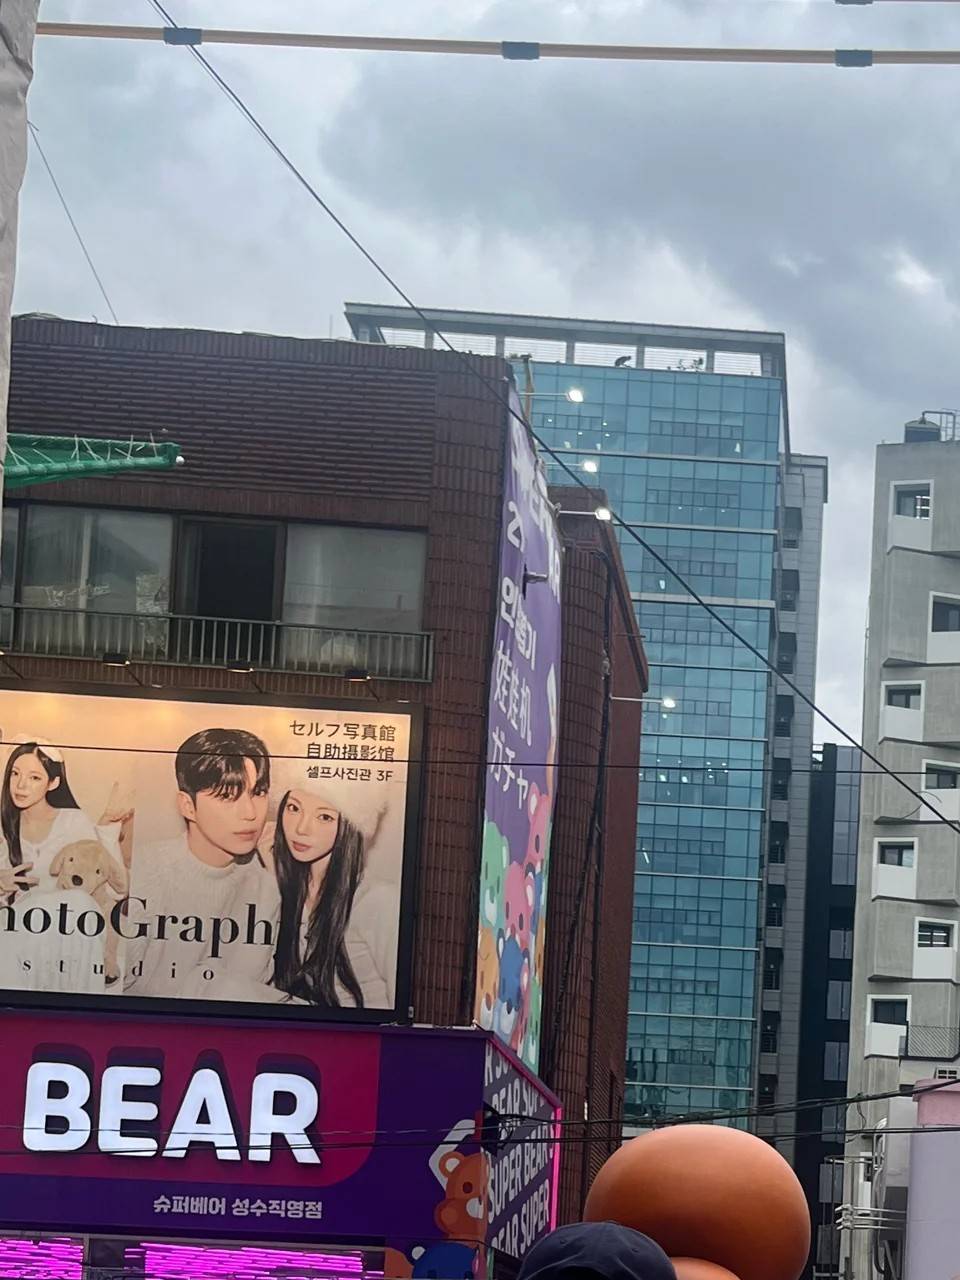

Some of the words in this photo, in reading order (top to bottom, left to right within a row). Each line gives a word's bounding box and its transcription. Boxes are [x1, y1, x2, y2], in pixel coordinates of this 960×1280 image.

[494, 639, 532, 747] 娃娃机
[290, 720, 396, 742] セルフ写真館
[307, 742, 395, 763] 自助摄影馆
[307, 765, 371, 781] 셀프사진관
[377, 769, 393, 781] 3F
[490, 726, 529, 809] ガチャ
[22, 959, 214, 981] studio
[23, 1062, 321, 1164] BEAR
[488, 1144, 522, 1224] SUPER
[524, 1119, 548, 1186] BEAR
[153, 1195, 226, 1215] 슈퍼베어
[231, 1198, 322, 1219] 성수직영점
[521, 1178, 549, 1255] SUPER
